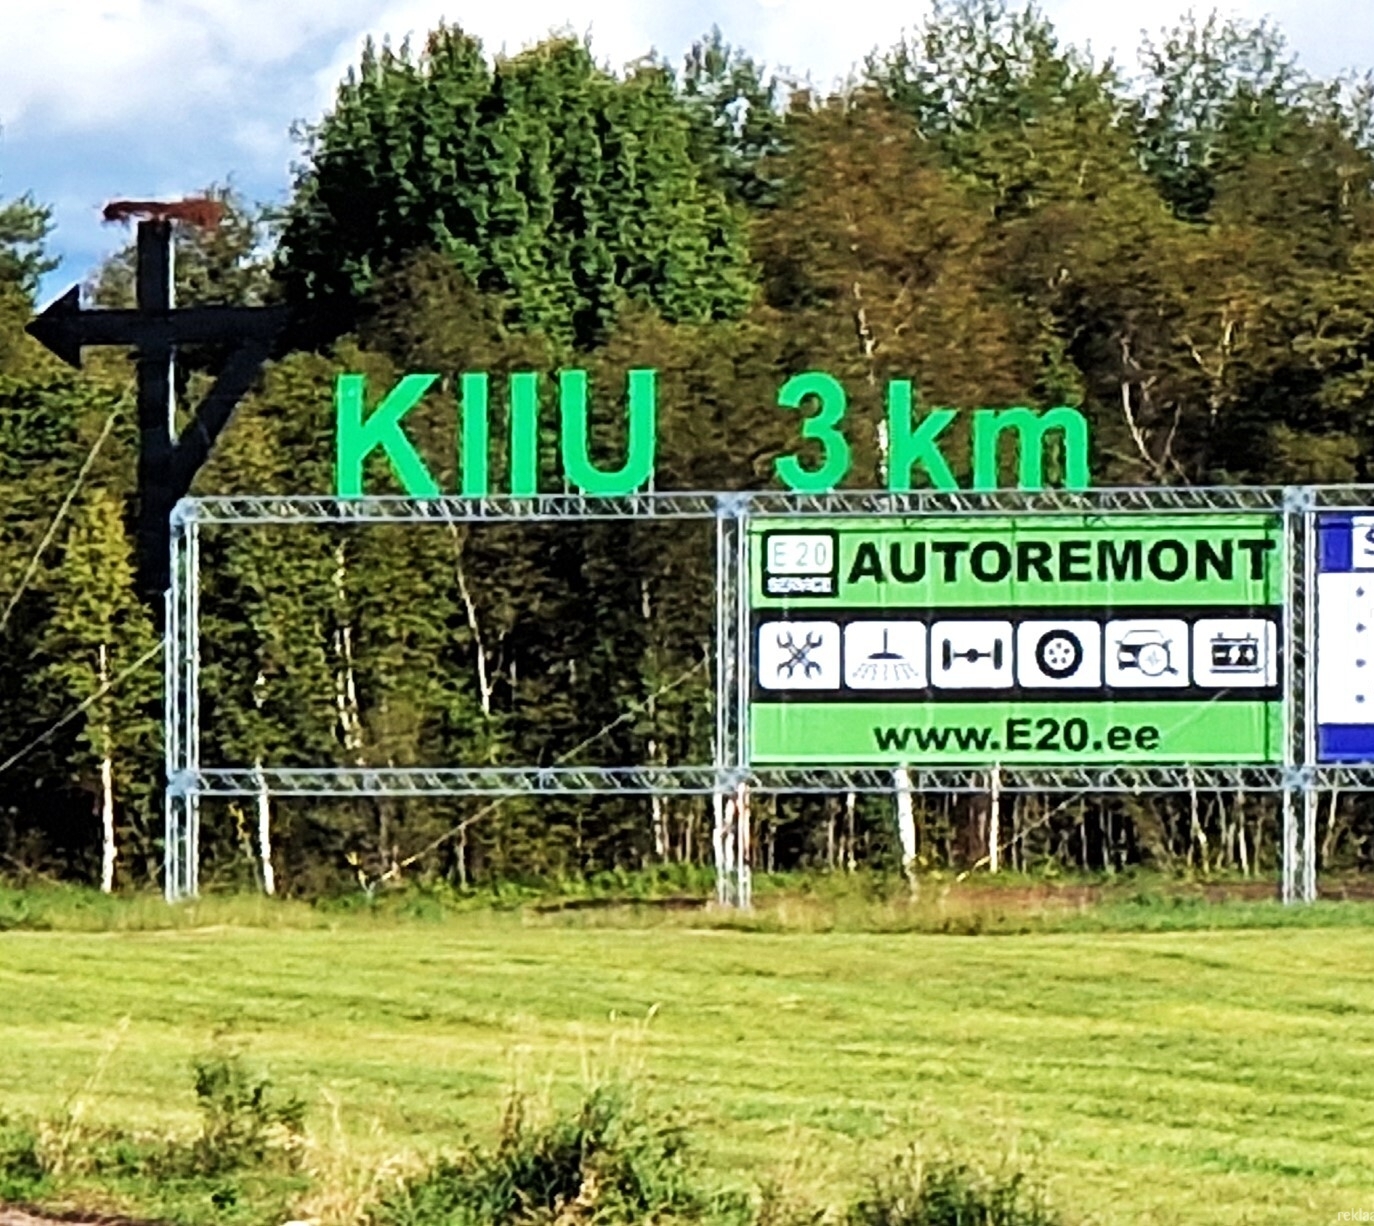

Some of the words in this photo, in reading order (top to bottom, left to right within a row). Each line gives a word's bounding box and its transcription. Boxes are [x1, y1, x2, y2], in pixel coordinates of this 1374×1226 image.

[335, 370, 656, 498] KIIU
[775, 372, 850, 493] 3
[887, 379, 1091, 492] km
[847, 538, 1276, 584] AUTOREMONT
[874, 717, 1159, 751] www.E20.ee
